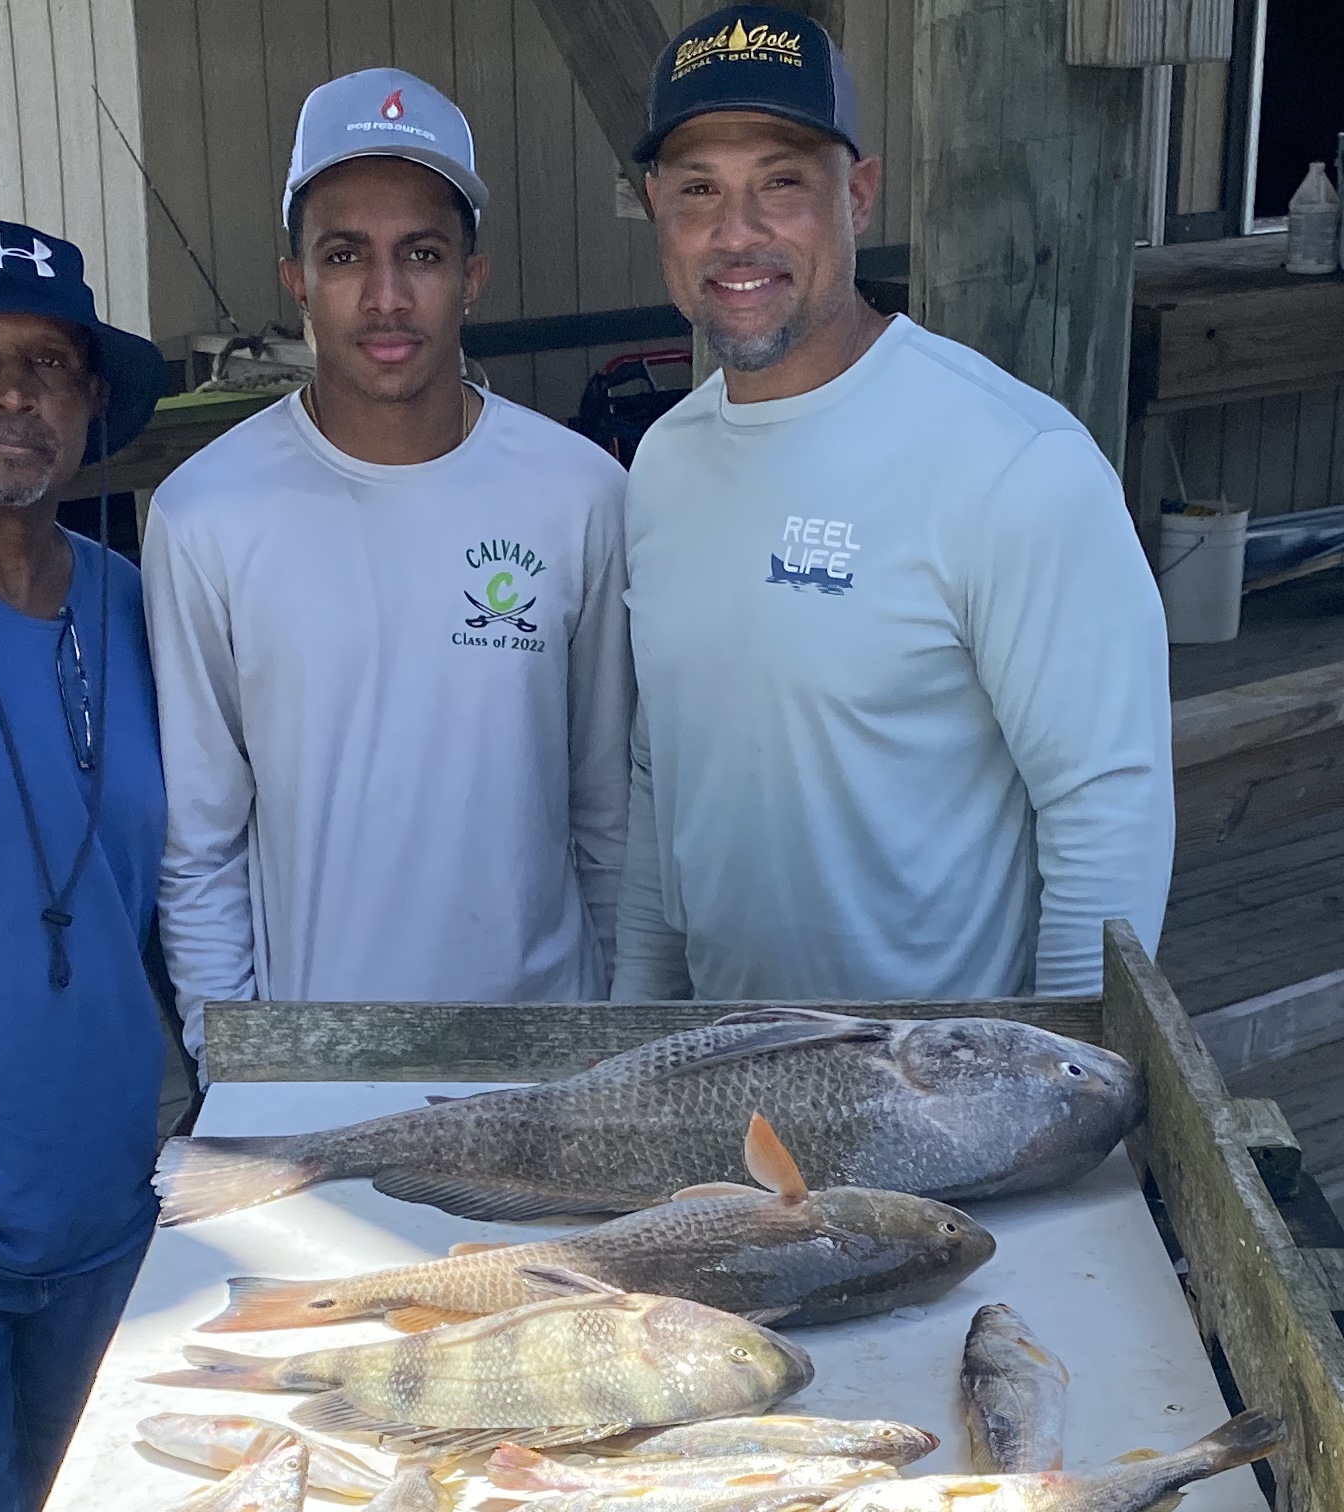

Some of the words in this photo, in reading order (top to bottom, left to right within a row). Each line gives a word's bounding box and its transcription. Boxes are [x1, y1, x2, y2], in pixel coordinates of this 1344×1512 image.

[675, 25, 730, 66] Black
[748, 24, 801, 52] Gold
[373, 121, 436, 142] resources
[783, 515, 860, 551] REEL
[466, 539, 547, 577] CALVARY
[783, 545, 851, 579] LIFE
[452, 632, 488, 646] Class
[492, 635, 508, 649] of
[511, 637, 546, 653] 2022
